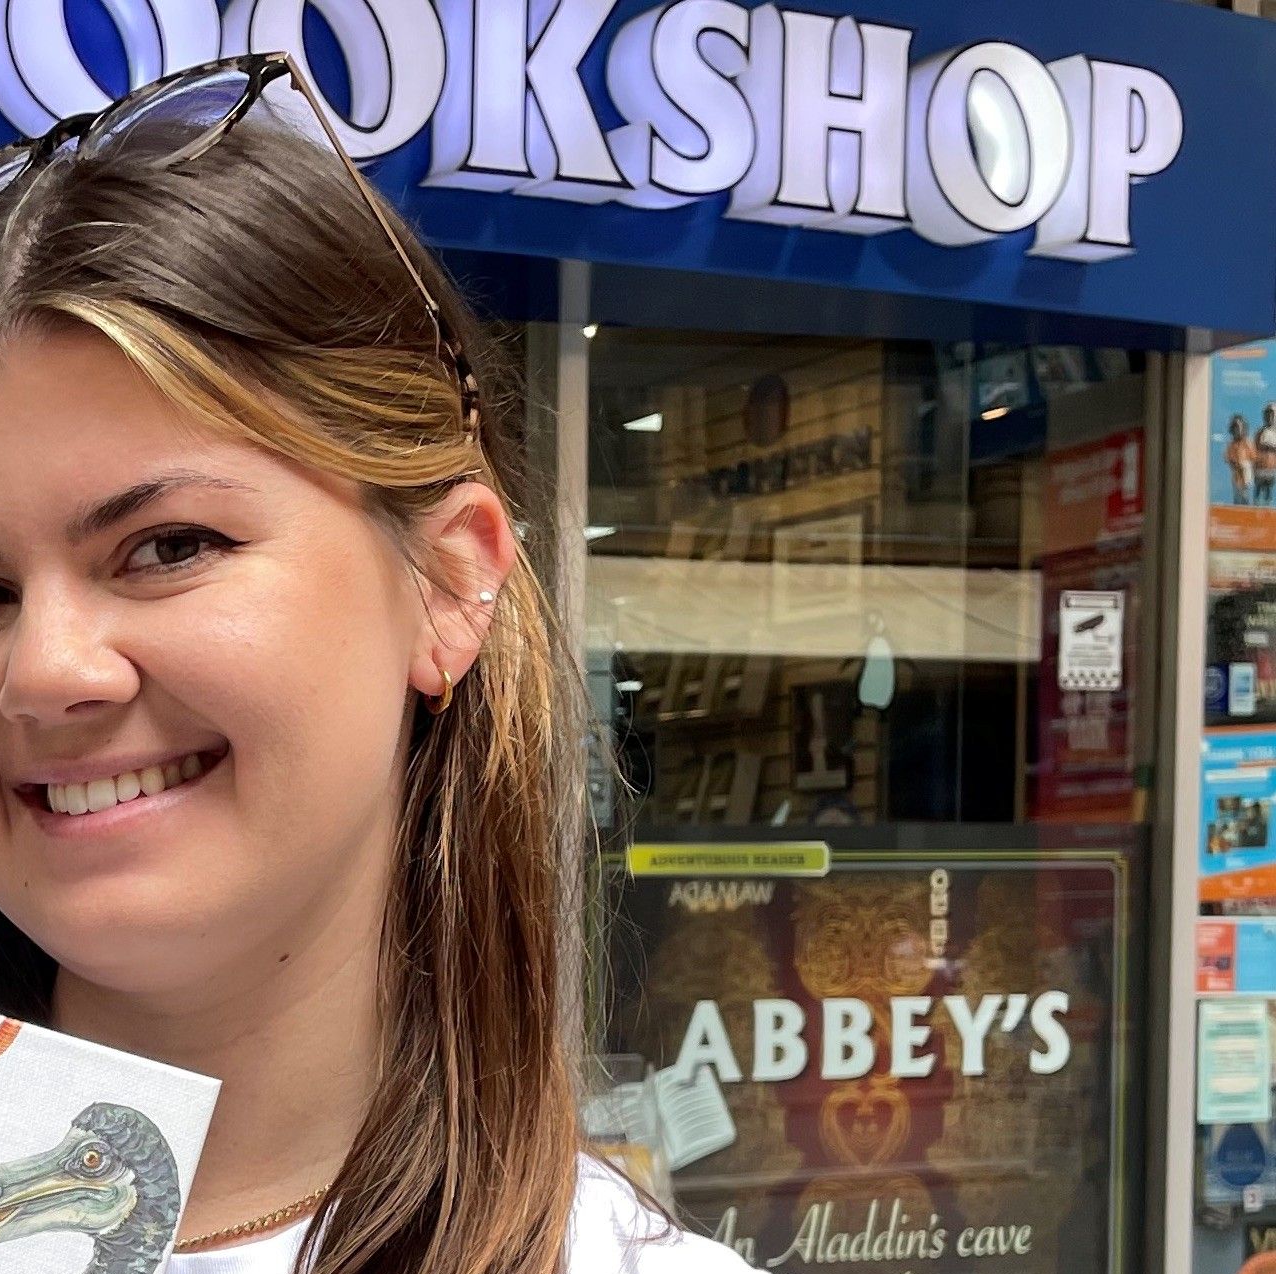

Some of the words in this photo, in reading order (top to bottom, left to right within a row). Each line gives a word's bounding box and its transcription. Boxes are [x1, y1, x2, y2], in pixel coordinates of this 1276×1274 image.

[676, 991, 1071, 1084] ABBEY'S
[766, 1198, 944, 1268] Aladdin's
[955, 1224, 1033, 1257] cave
